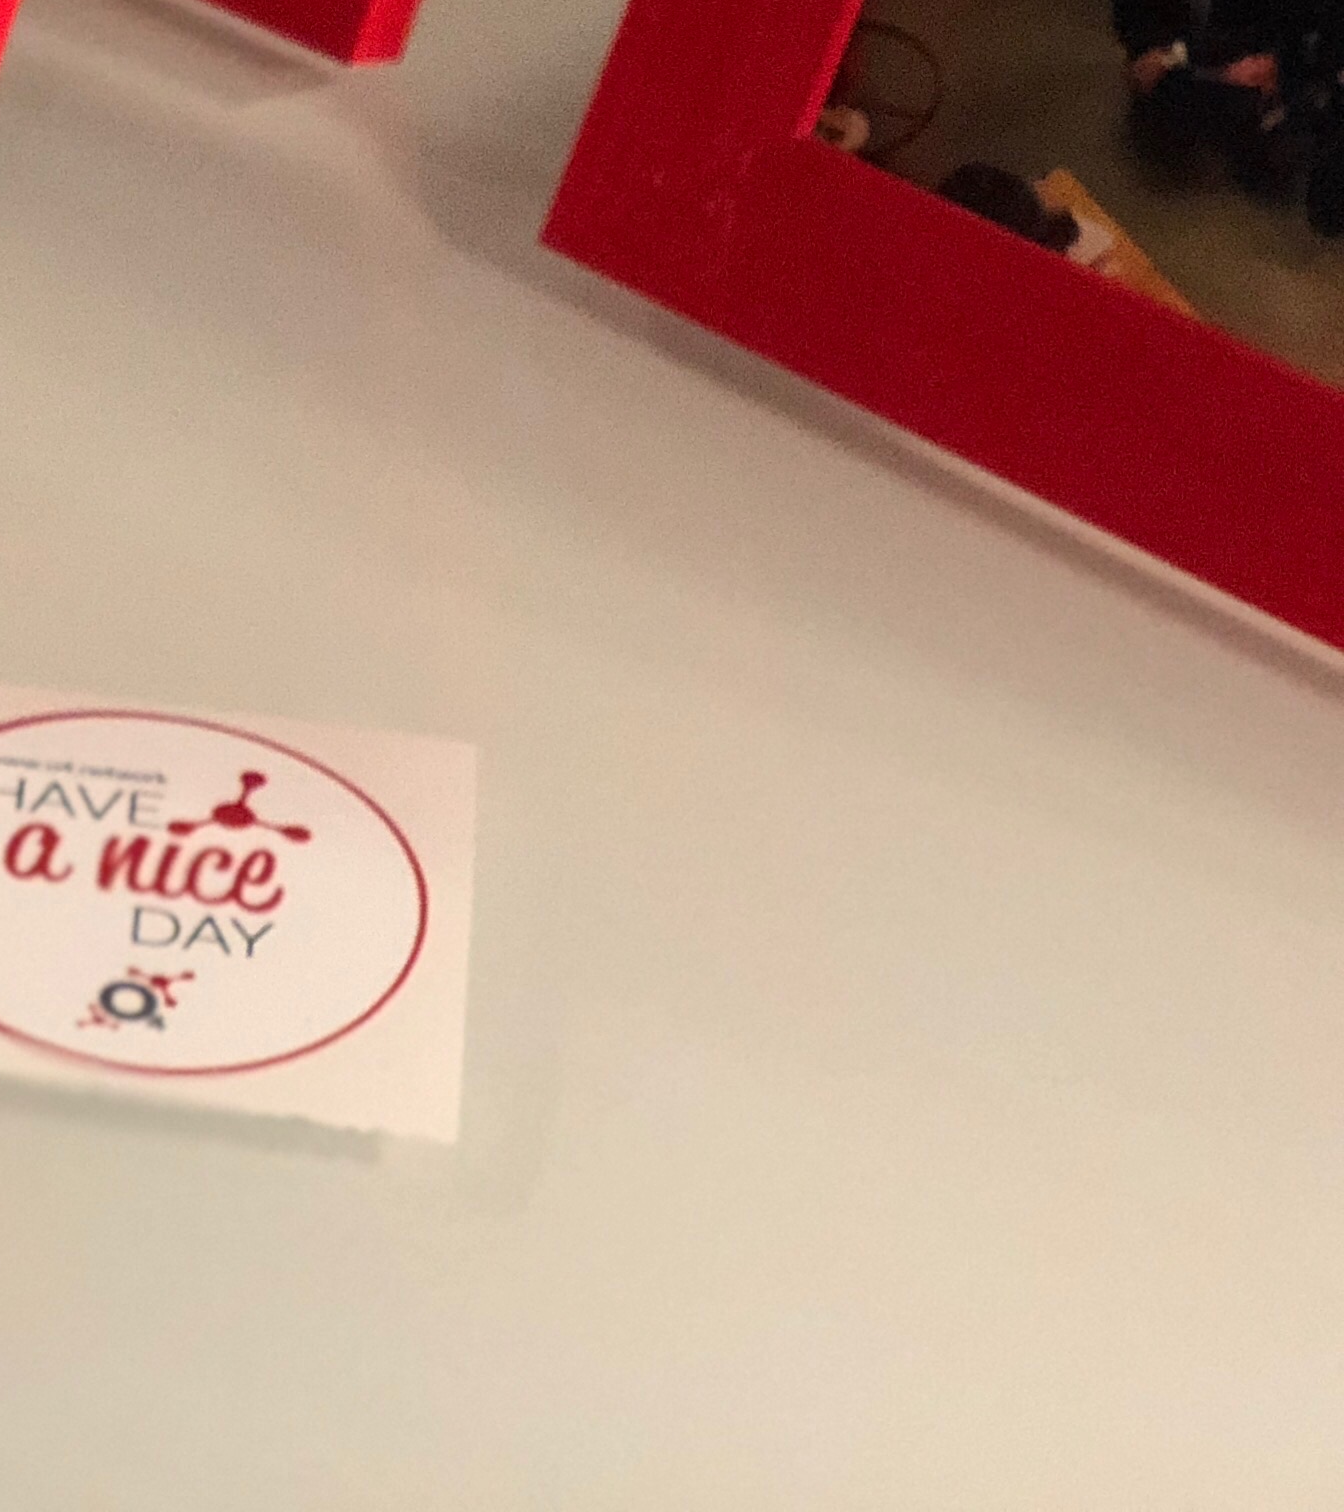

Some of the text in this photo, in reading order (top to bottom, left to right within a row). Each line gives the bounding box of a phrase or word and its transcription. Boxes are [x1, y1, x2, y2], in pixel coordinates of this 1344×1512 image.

[3, 822, 285, 913] a nice
[131, 905, 274, 958] DAY
